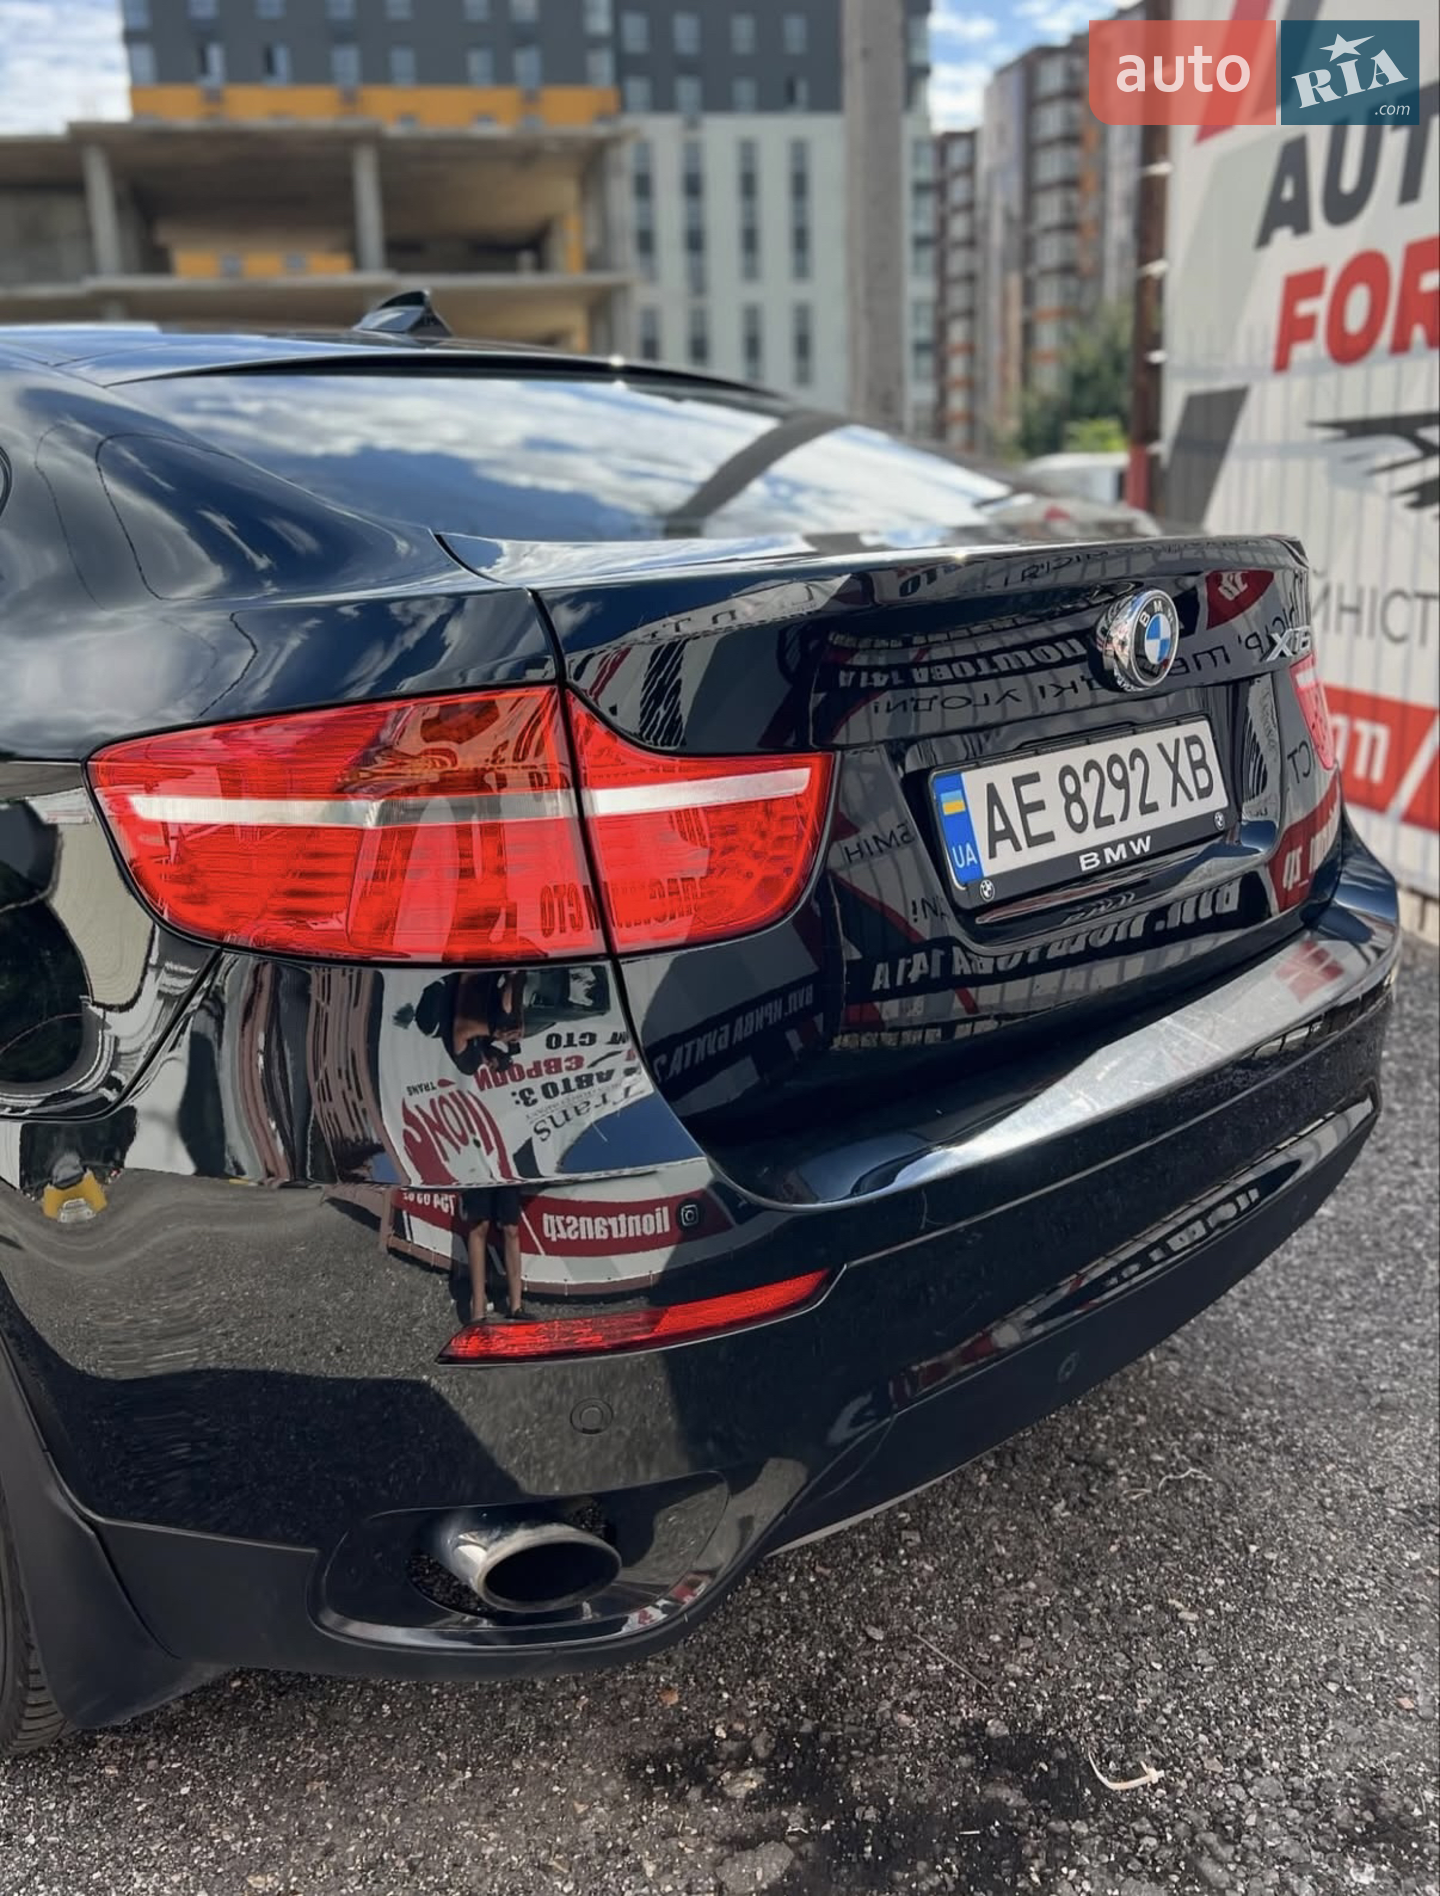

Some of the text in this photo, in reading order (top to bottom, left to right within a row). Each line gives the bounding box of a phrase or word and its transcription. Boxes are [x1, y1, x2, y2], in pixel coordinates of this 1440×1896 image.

[986, 734, 1214, 860] AE 8292 XB
[952, 843, 978, 869] UA
[1079, 837, 1152, 873] BMW
